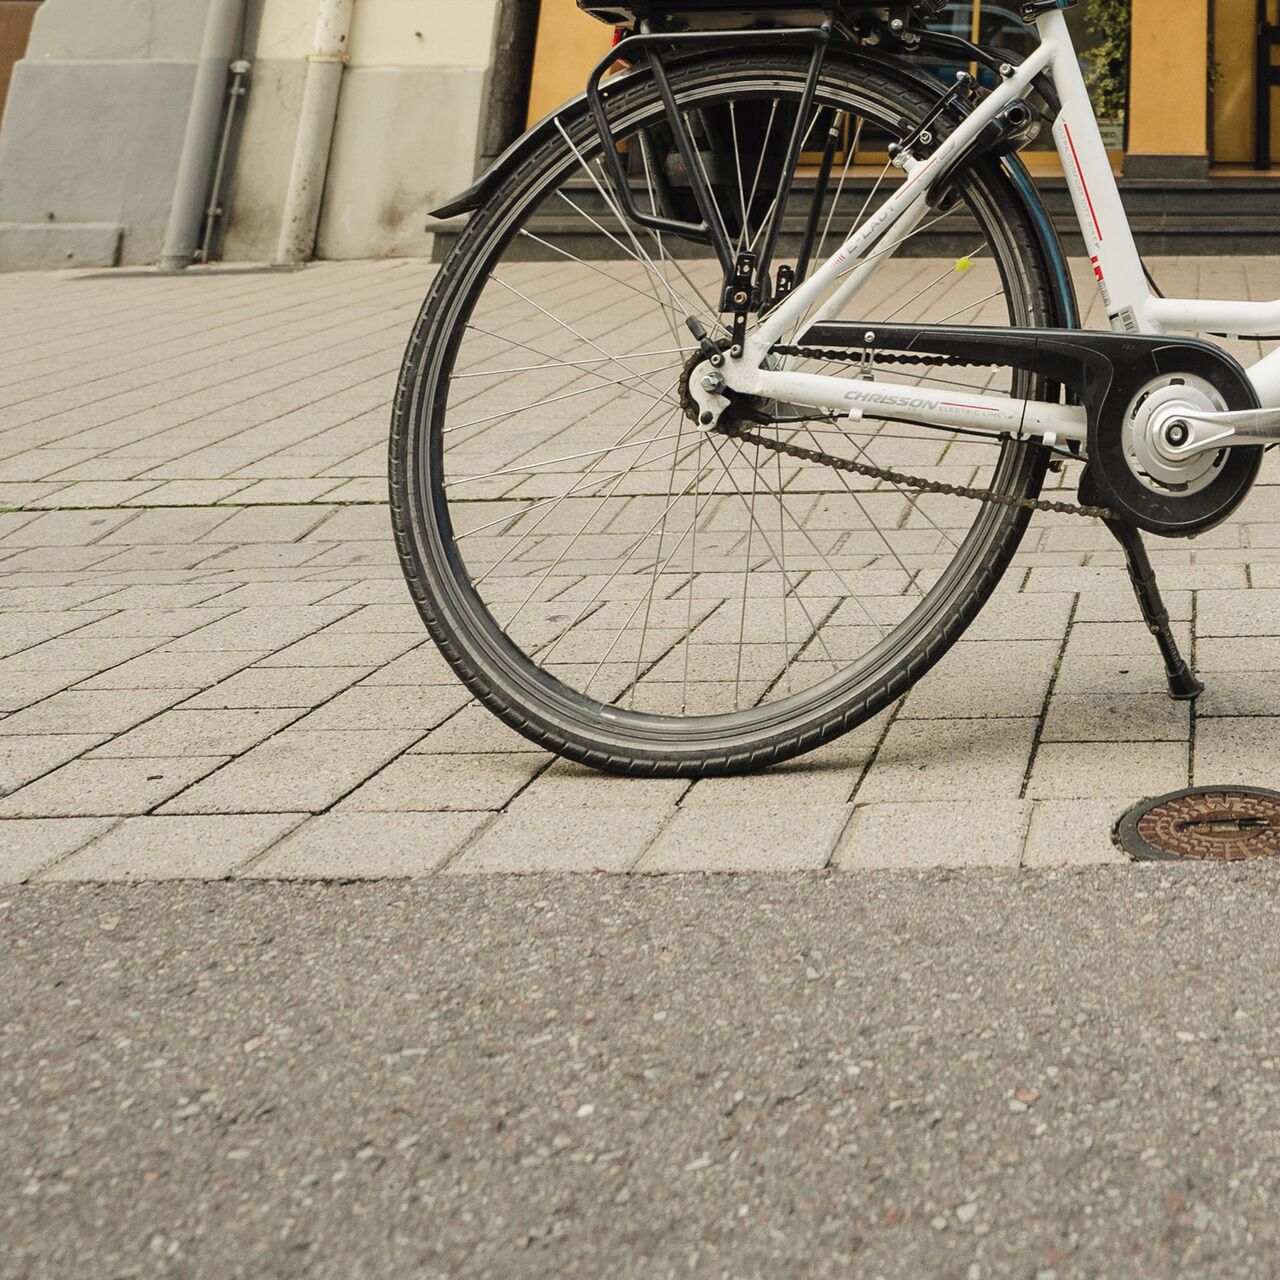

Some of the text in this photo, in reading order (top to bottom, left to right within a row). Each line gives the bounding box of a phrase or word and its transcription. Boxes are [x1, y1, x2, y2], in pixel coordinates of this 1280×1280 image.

[847, 203, 895, 255] E-LADY
[844, 390, 939, 410] CHRISSON
[938, 406, 981, 416] ELECTRIC
